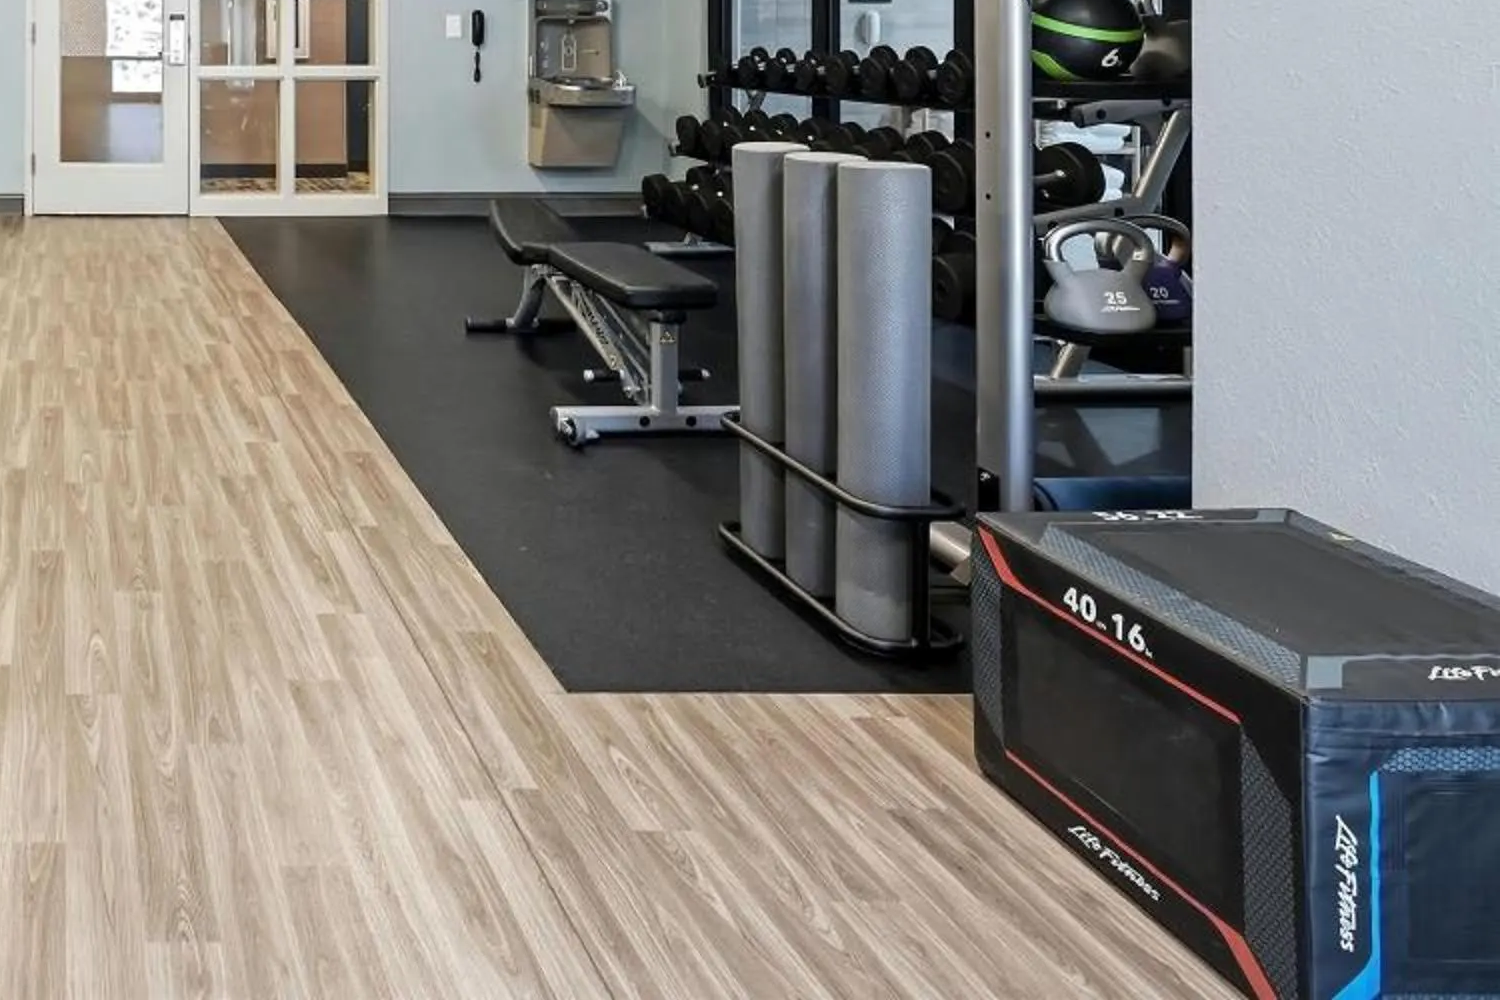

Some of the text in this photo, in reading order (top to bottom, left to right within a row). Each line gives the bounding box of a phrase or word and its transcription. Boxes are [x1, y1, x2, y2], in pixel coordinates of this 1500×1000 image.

[1101, 48, 1119, 67] 6
[1103, 291, 1128, 305] 25
[1150, 286, 1169, 299] 20
[1063, 587, 1146, 653] 40 16
